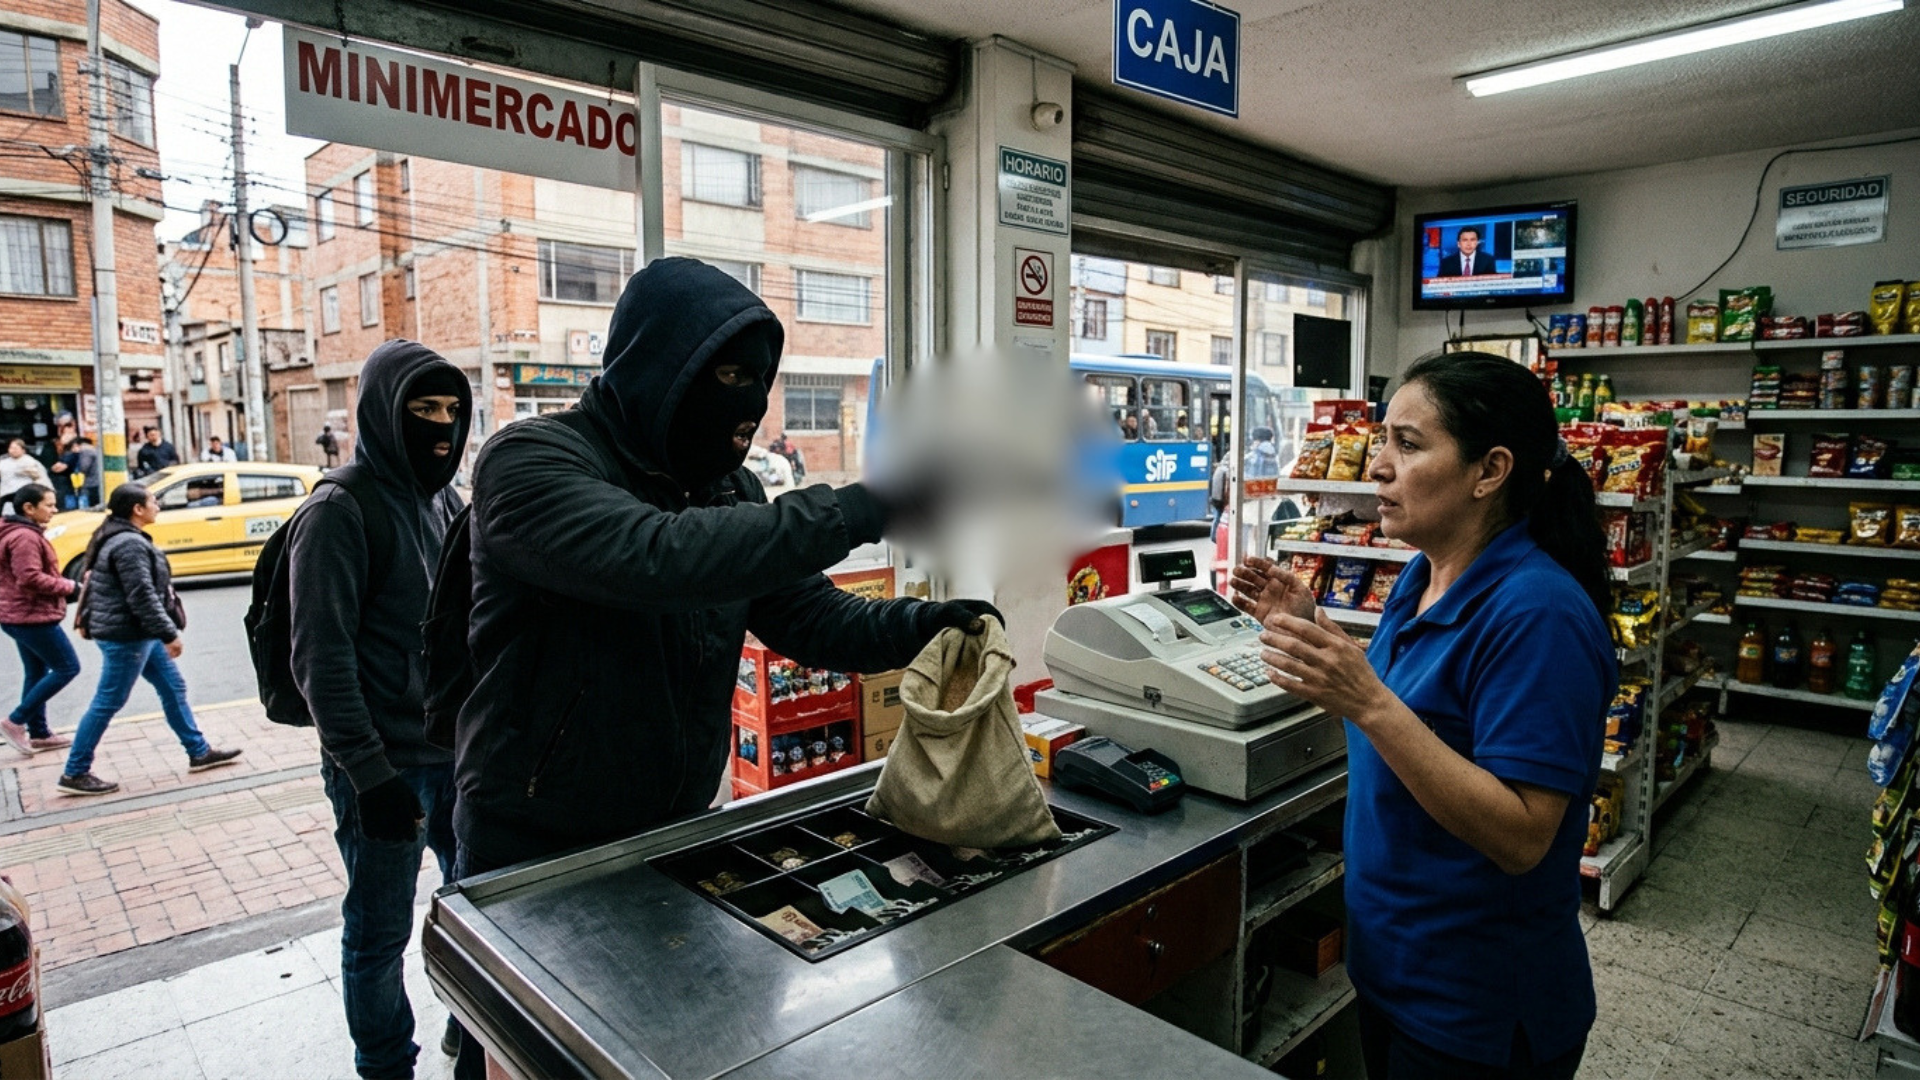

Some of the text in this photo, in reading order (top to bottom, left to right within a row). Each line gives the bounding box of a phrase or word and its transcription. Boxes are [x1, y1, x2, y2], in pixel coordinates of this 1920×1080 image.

[1127, 8, 1230, 84] CAJA
[297, 40, 636, 157] MINIMERCADO
[1005, 154, 1064, 183] HORARIO
[1786, 183, 1880, 206] SEGURIDAD
